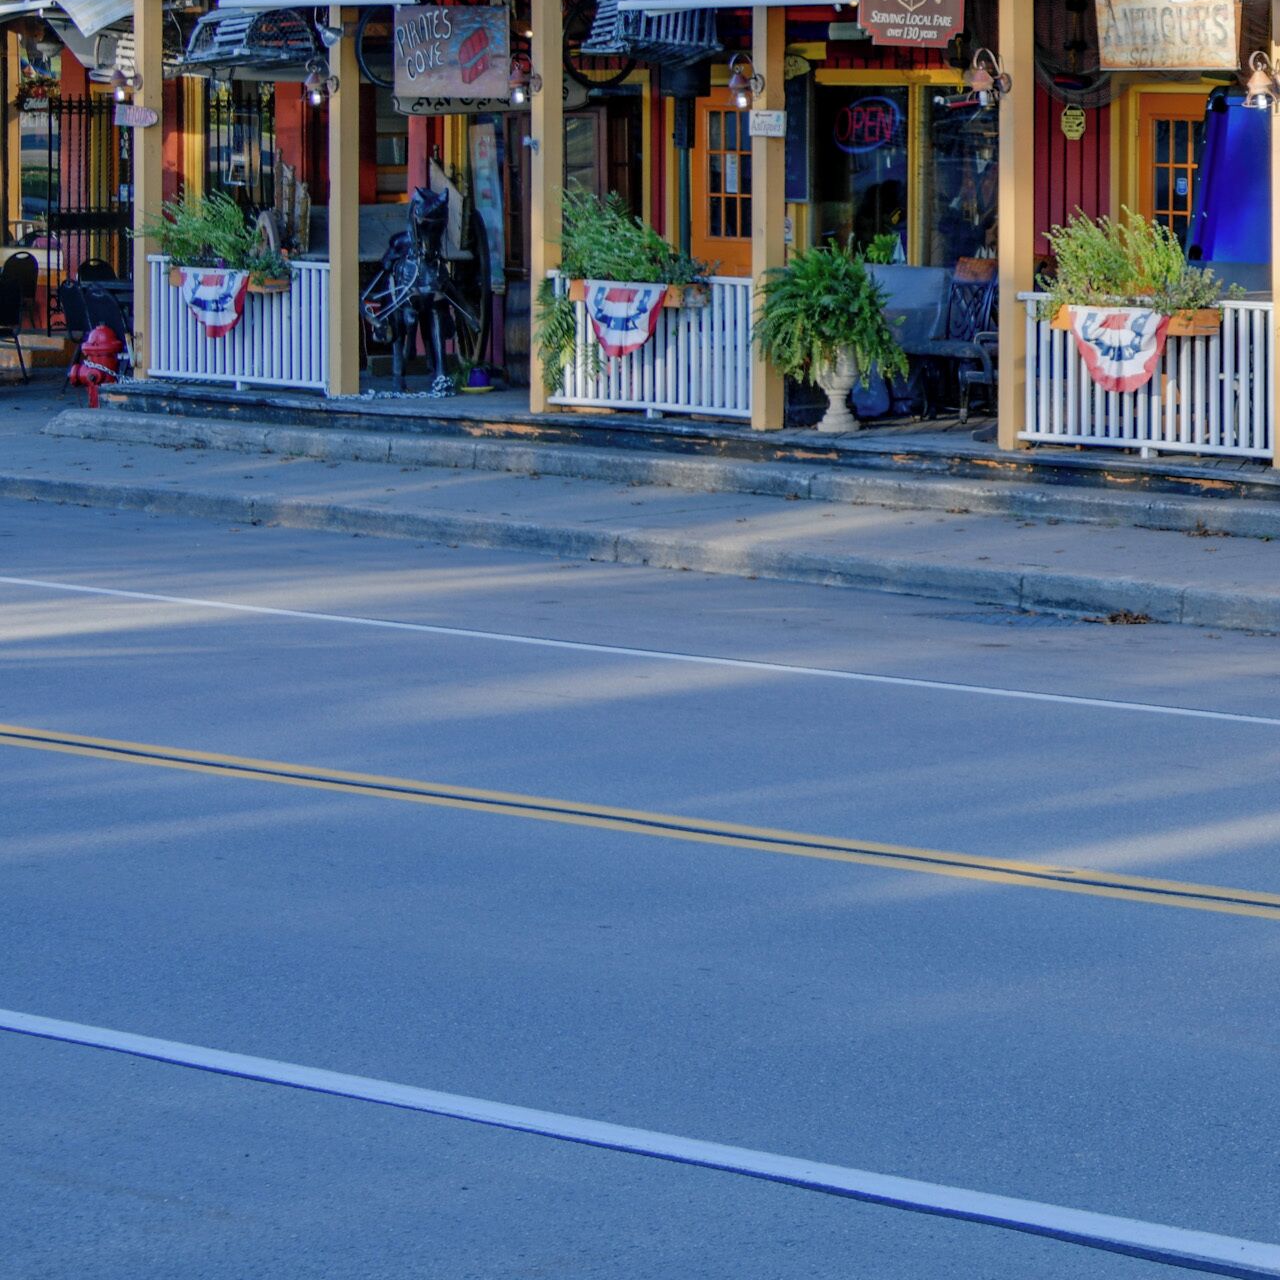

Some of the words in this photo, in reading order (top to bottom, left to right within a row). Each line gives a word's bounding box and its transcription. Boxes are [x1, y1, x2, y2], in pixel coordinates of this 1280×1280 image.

[396, 8, 452, 58] PIRATE'S
[870, 10, 905, 26] SERVING
[905, 12, 932, 26] LOCAL
[932, 14, 953, 27] FARE
[886, 28, 903, 38] over
[902, 27, 920, 40] 130
[918, 29, 938, 41] years
[406, 41, 445, 81] COVE
[834, 106, 893, 144] OPEN
